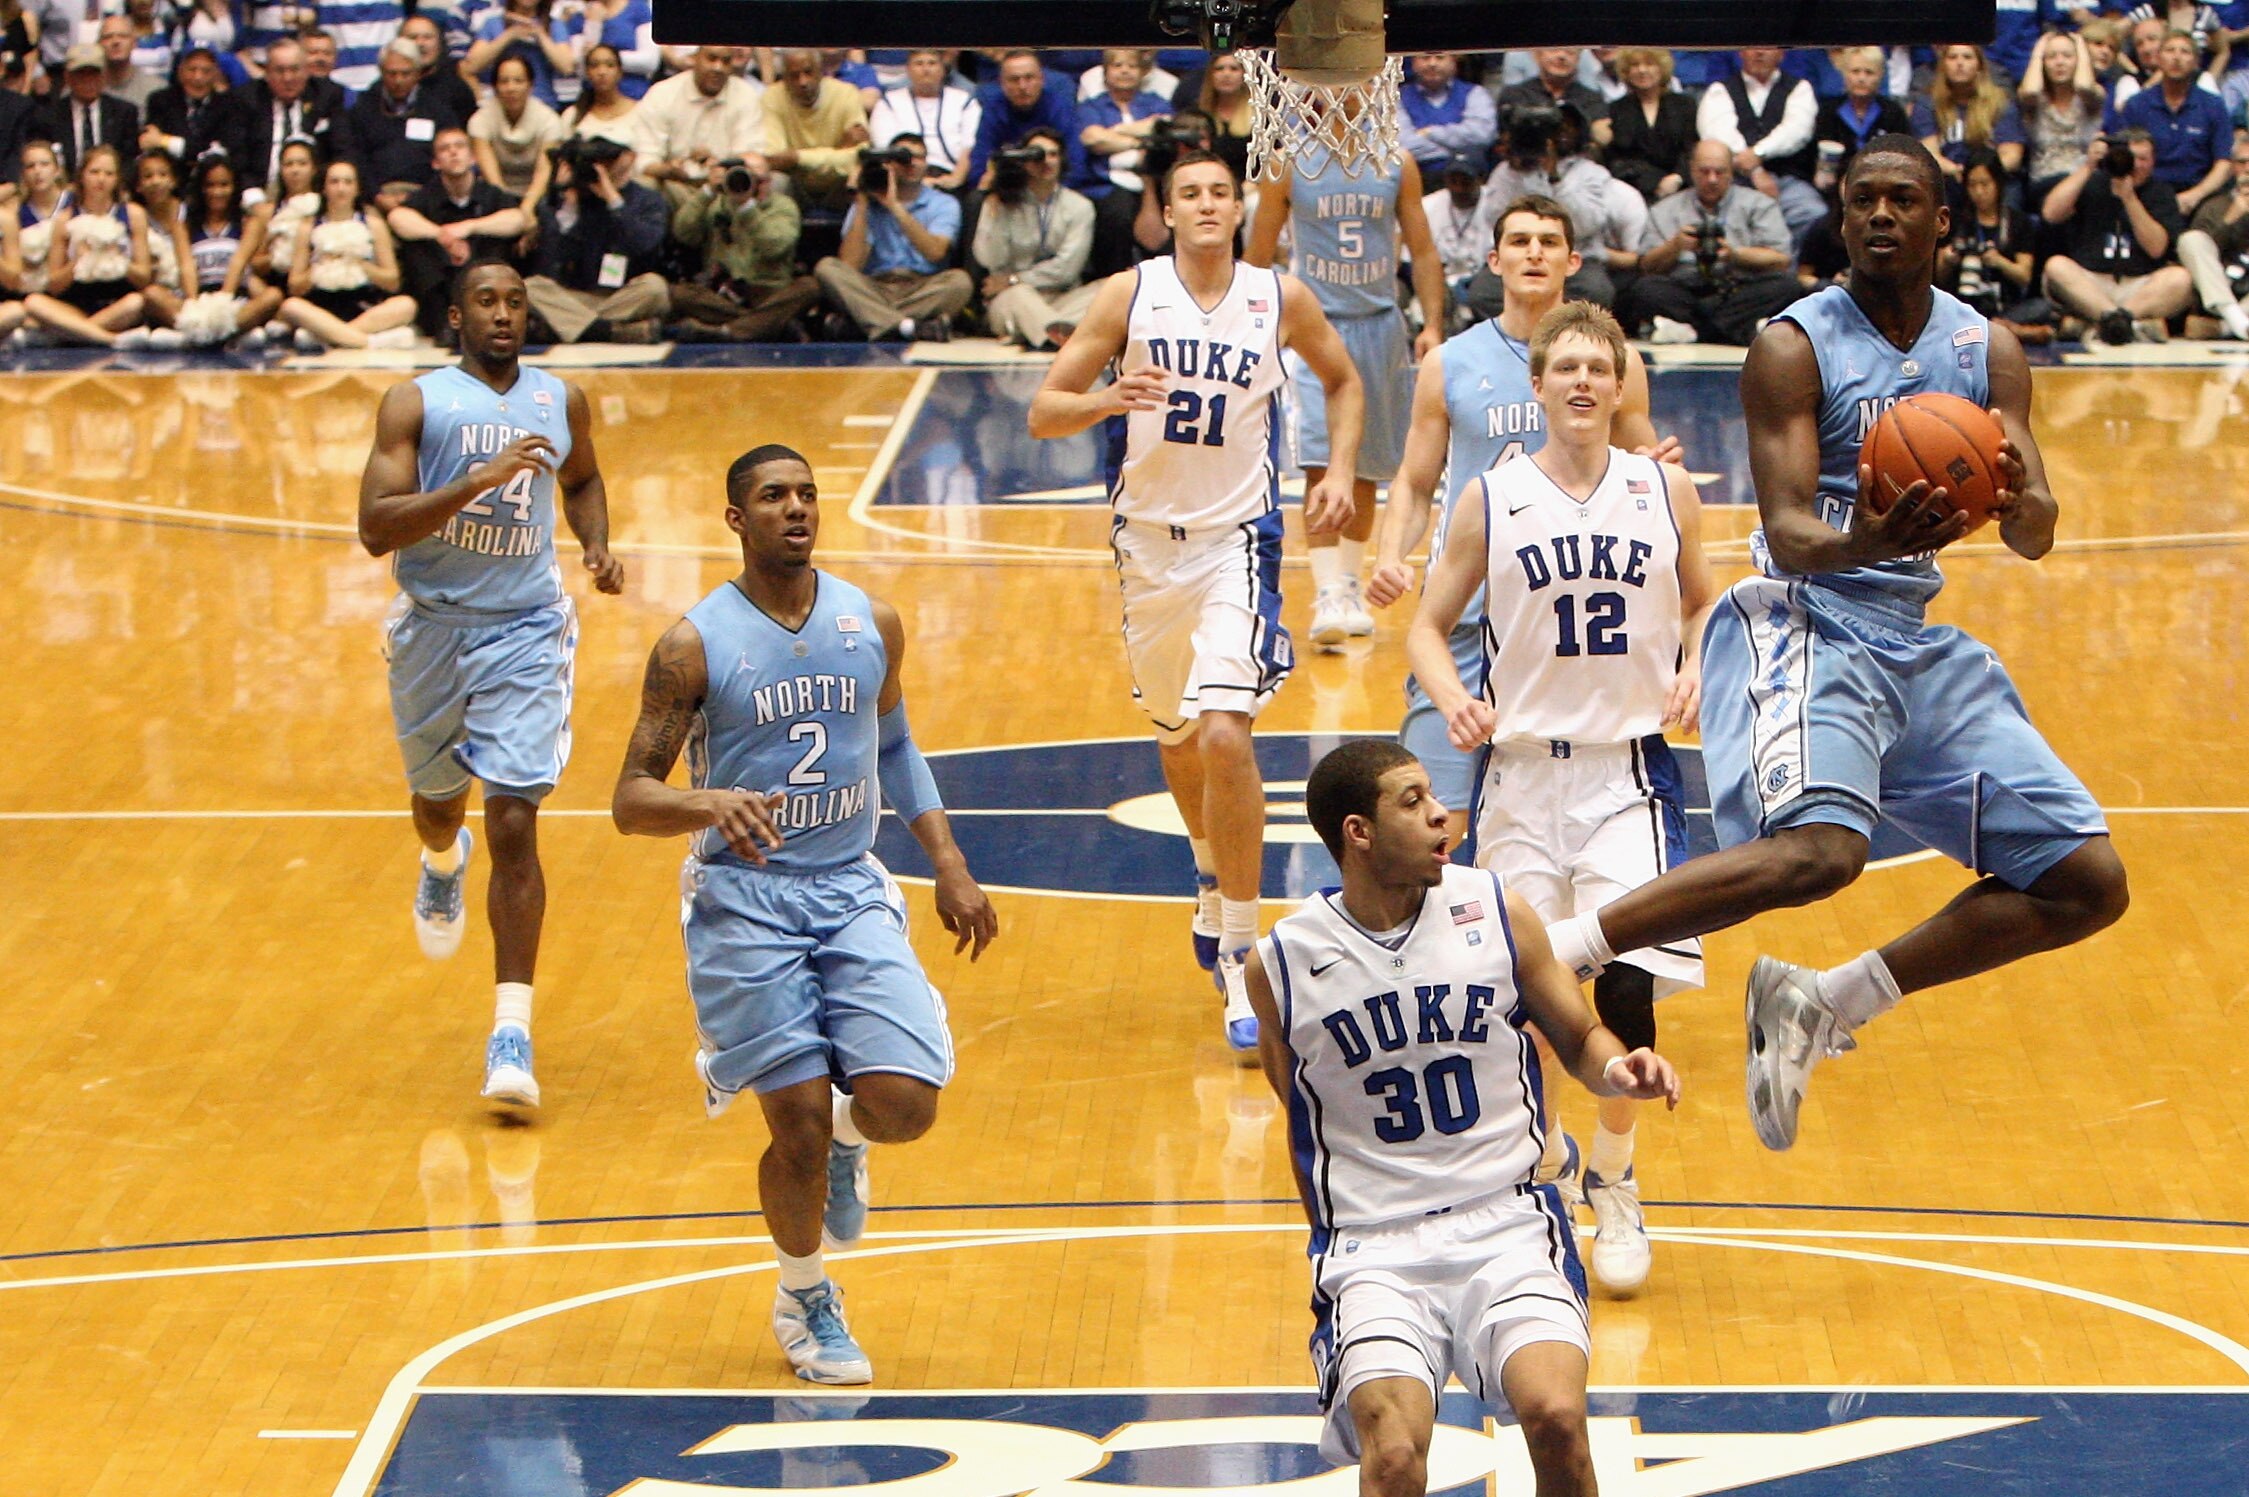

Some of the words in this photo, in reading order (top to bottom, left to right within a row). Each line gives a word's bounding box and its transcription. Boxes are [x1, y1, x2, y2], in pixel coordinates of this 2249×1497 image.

[1317, 192, 1385, 218] NORTH
[1338, 220, 1364, 258] 5
[1306, 253, 1388, 286] CAROLINA
[1148, 338, 1262, 390] DUKE
[1163, 389, 1226, 447] 21
[1486, 401, 1541, 439] NOR
[432, 514, 543, 557] AROLINA
[1515, 534, 1653, 592] DUKE
[1553, 591, 1628, 657] 12
[753, 674, 858, 726] NORTH
[787, 720, 829, 786] 2
[733, 776, 868, 829] ROLINA
[1322, 984, 1495, 1069] DUKE
[1363, 1054, 1481, 1143] 30
